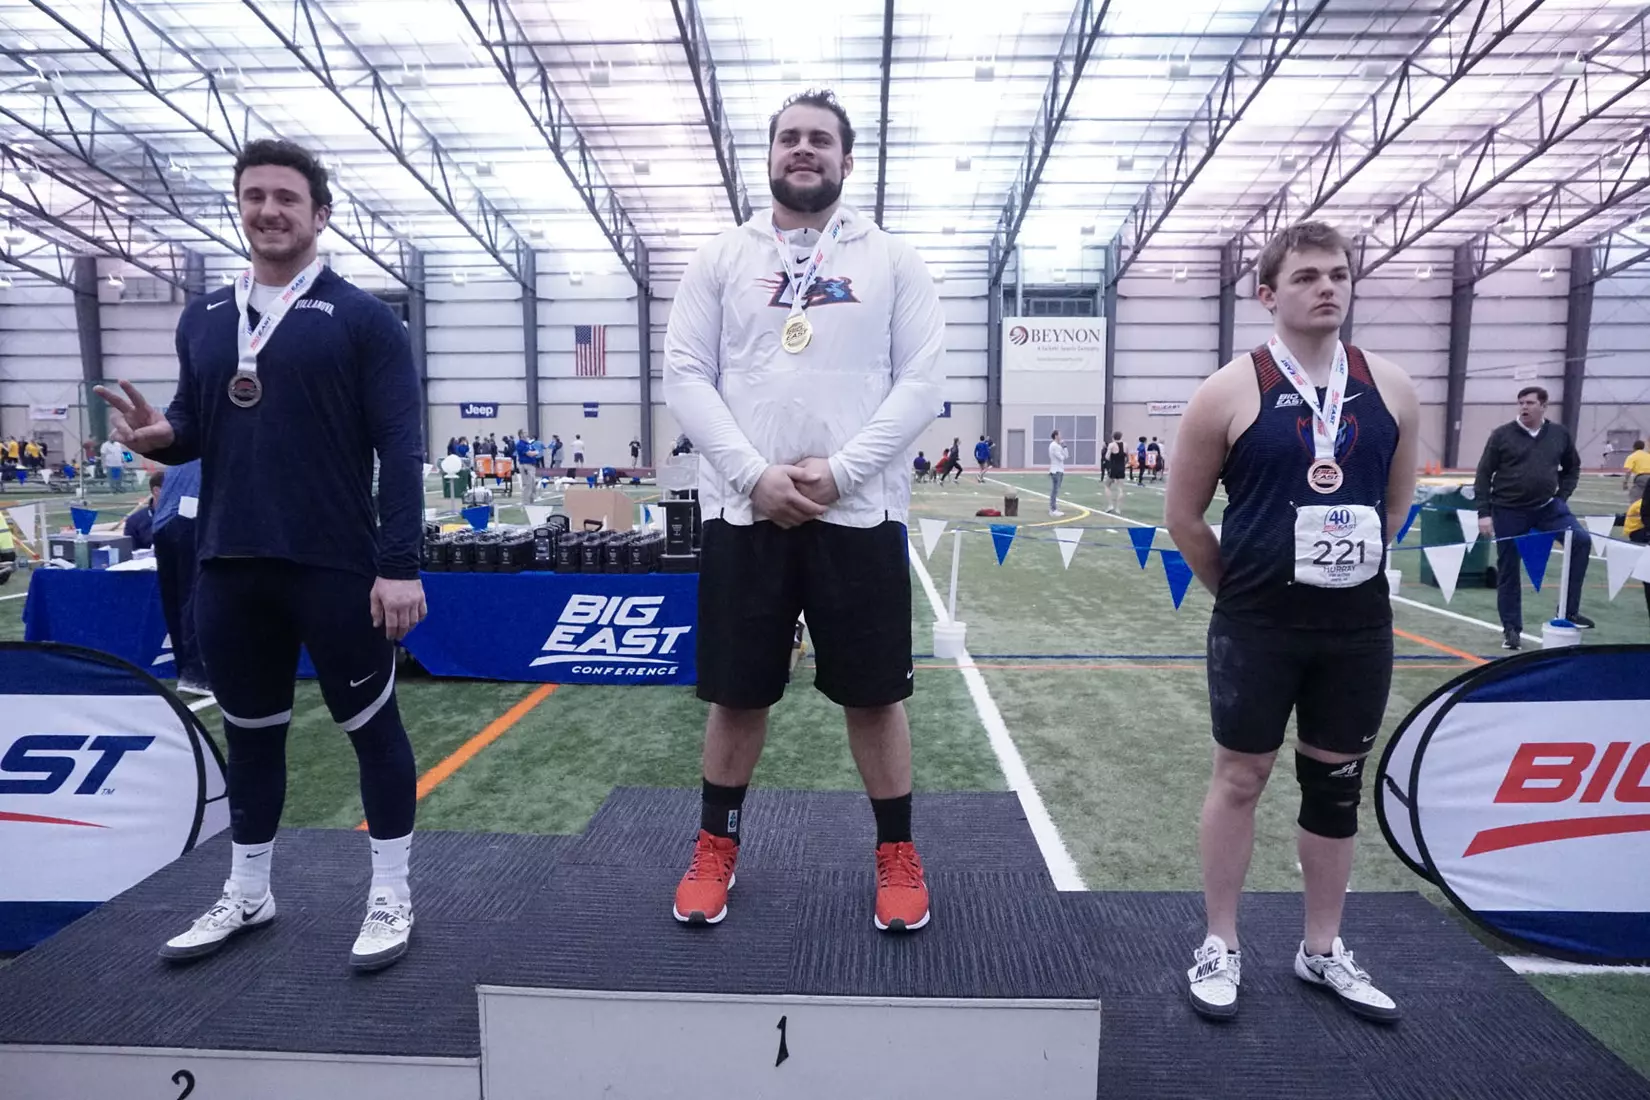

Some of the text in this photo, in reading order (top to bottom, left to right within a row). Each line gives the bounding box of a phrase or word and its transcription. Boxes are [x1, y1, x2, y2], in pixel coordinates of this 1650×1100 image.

[291, 276, 306, 291] EAST
[295, 299, 335, 317] VILLANOVA
[1031, 329, 1101, 342] BEYNON
[1281, 359, 1297, 375] EAST
[465, 404, 494, 416] Jeep
[1330, 404, 1338, 425] EAST
[1329, 509, 1350, 525] 40
[1312, 539, 1365, 565] 221
[557, 594, 665, 626] BIG
[541, 624, 692, 655] EAST
[572, 665, 679, 676] CONFERENCE
[366, 910, 400, 926] NIKE
[1195, 956, 1221, 980] NIKE
[775, 1015, 789, 1067] 1
